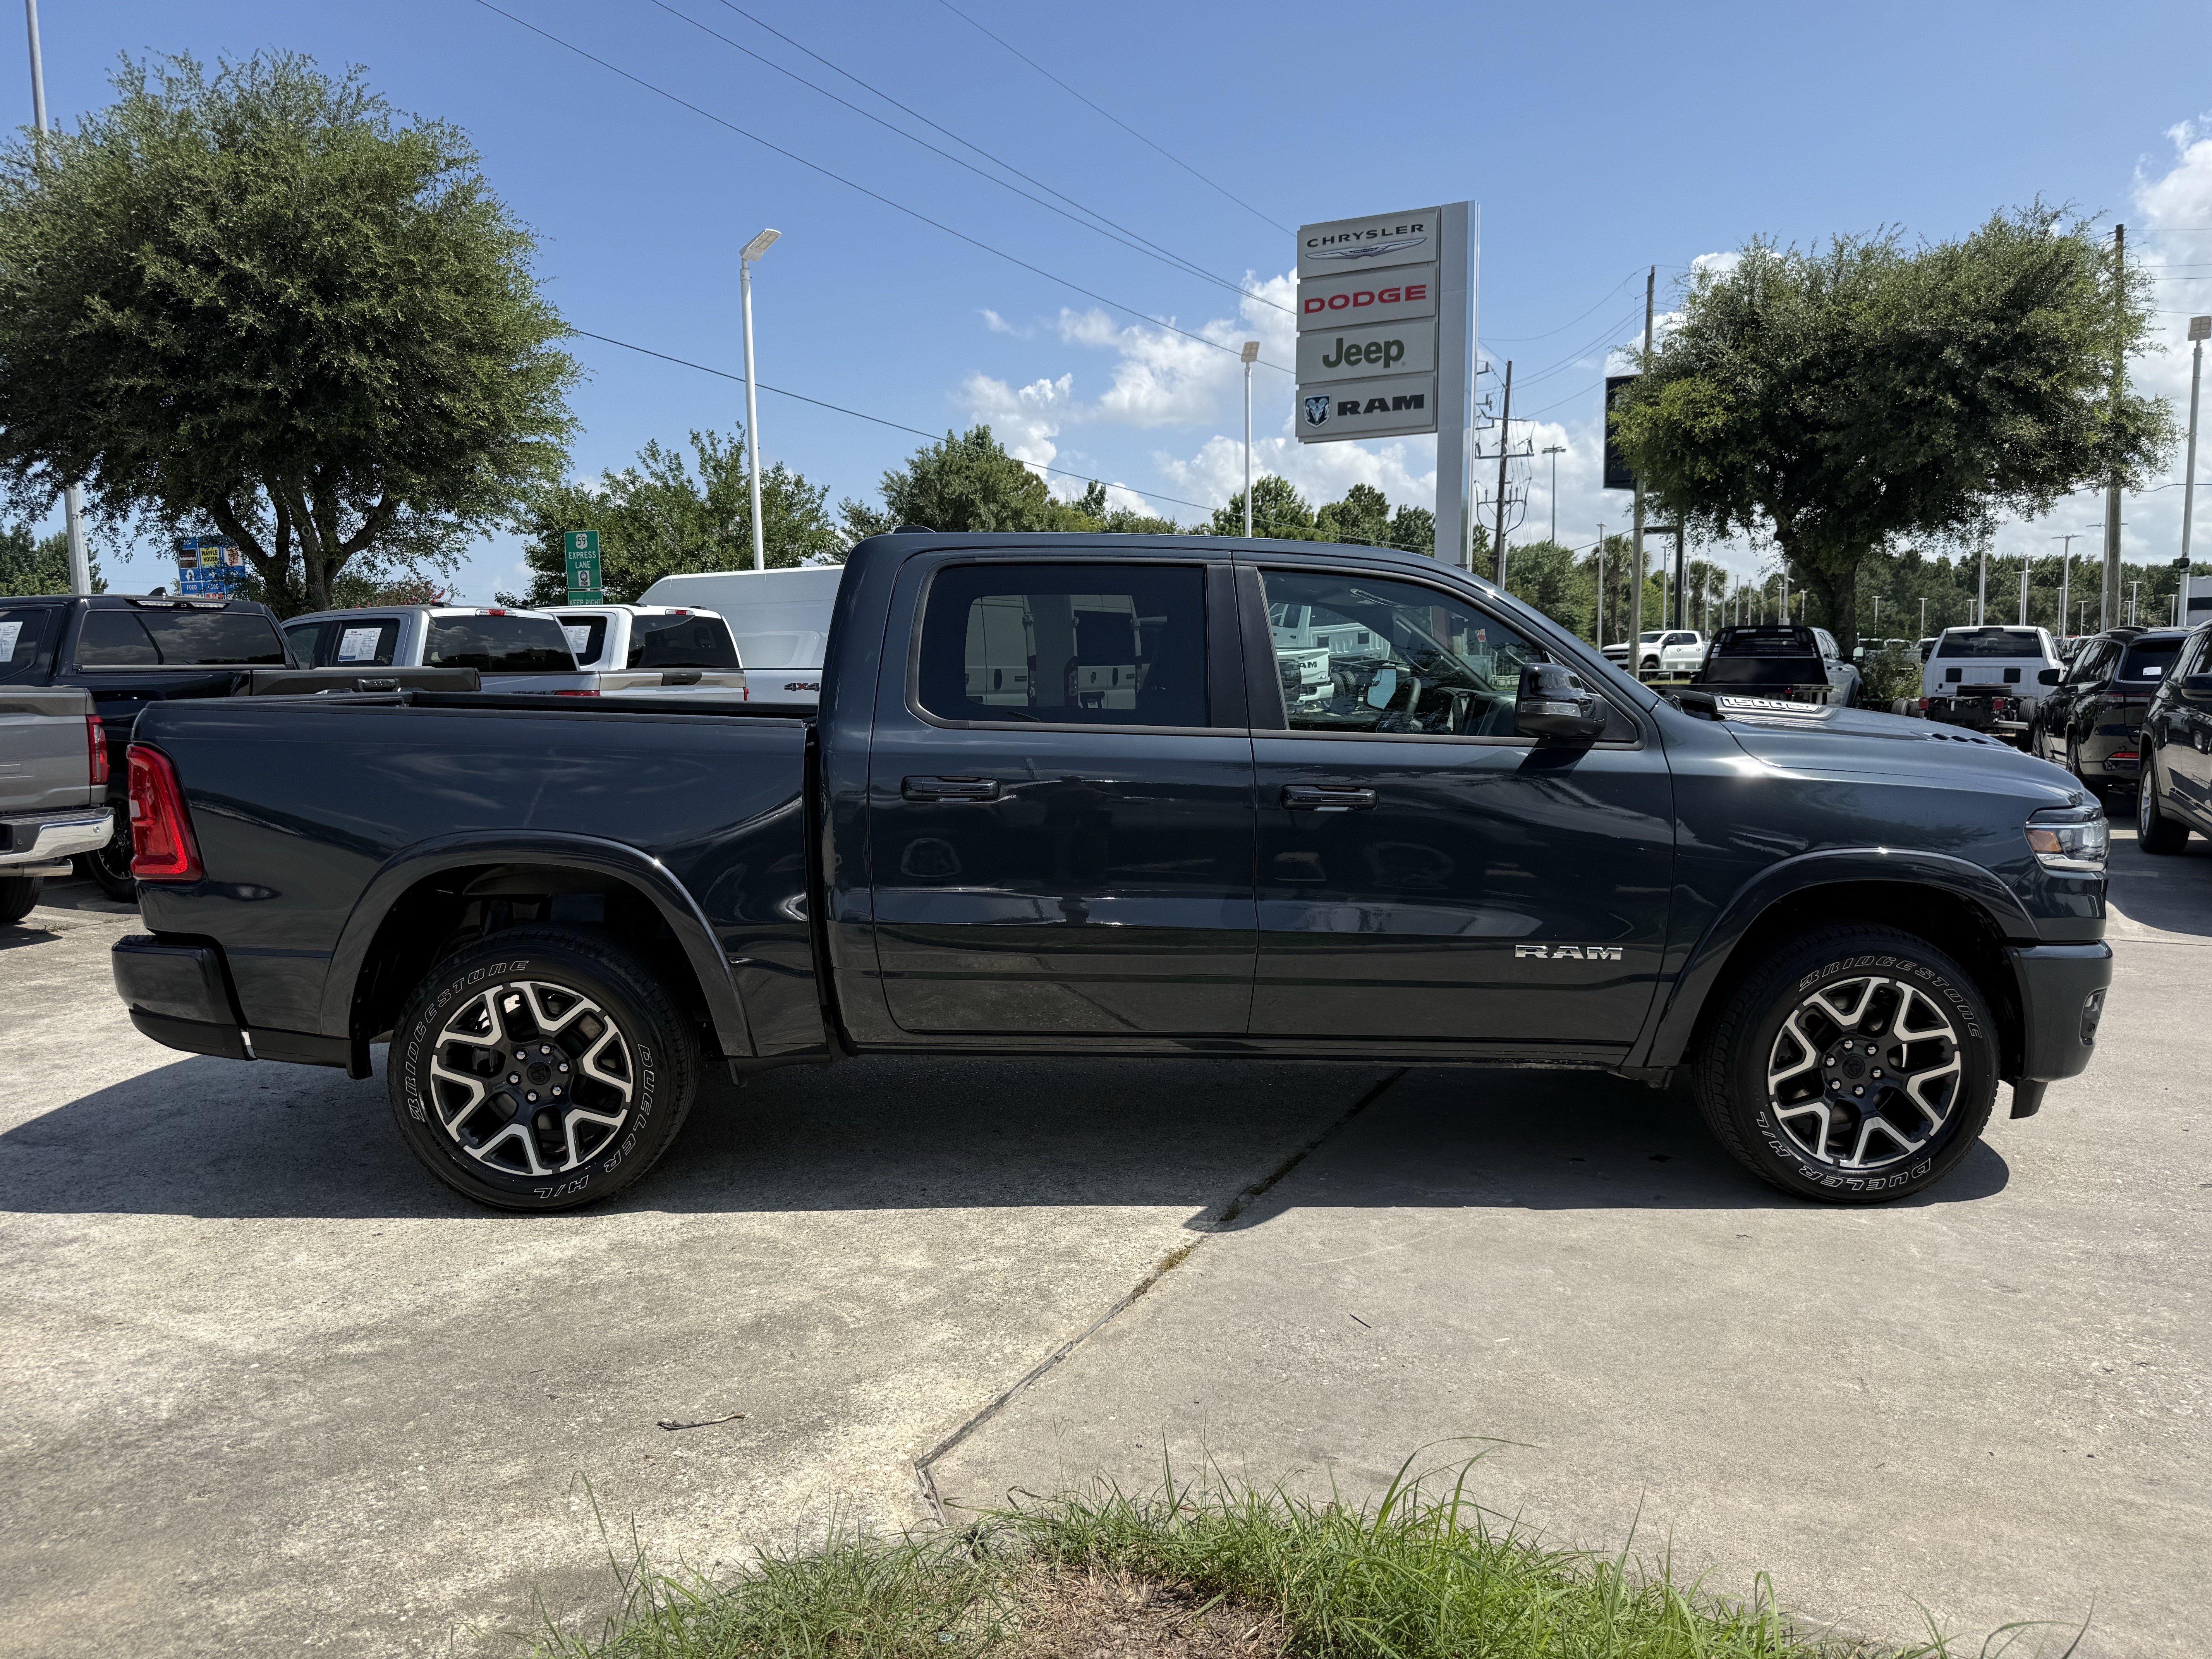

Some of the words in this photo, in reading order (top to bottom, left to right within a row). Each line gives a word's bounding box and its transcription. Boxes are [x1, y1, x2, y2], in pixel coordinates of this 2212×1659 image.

[1307, 223, 1424, 247] CHRYSLER
[1304, 284, 1427, 314] DODGE
[1322, 338, 1405, 369] Jeep
[1337, 394, 1424, 416] RAM
[568, 551, 596, 559] EXPRESS
[577, 537, 586, 546] 59
[1723, 697, 1786, 709] 1500
[1515, 945, 1623, 960] RAM
[1799, 956, 1982, 1038] BRIDGESTONE
[405, 960, 529, 1122] BRIDGESTONE
[604, 1044, 654, 1173] DUELER
[1756, 1111, 1791, 1157] H/L
[534, 1175, 589, 1199] H/L
[1799, 1158, 1931, 1191] DUELER
